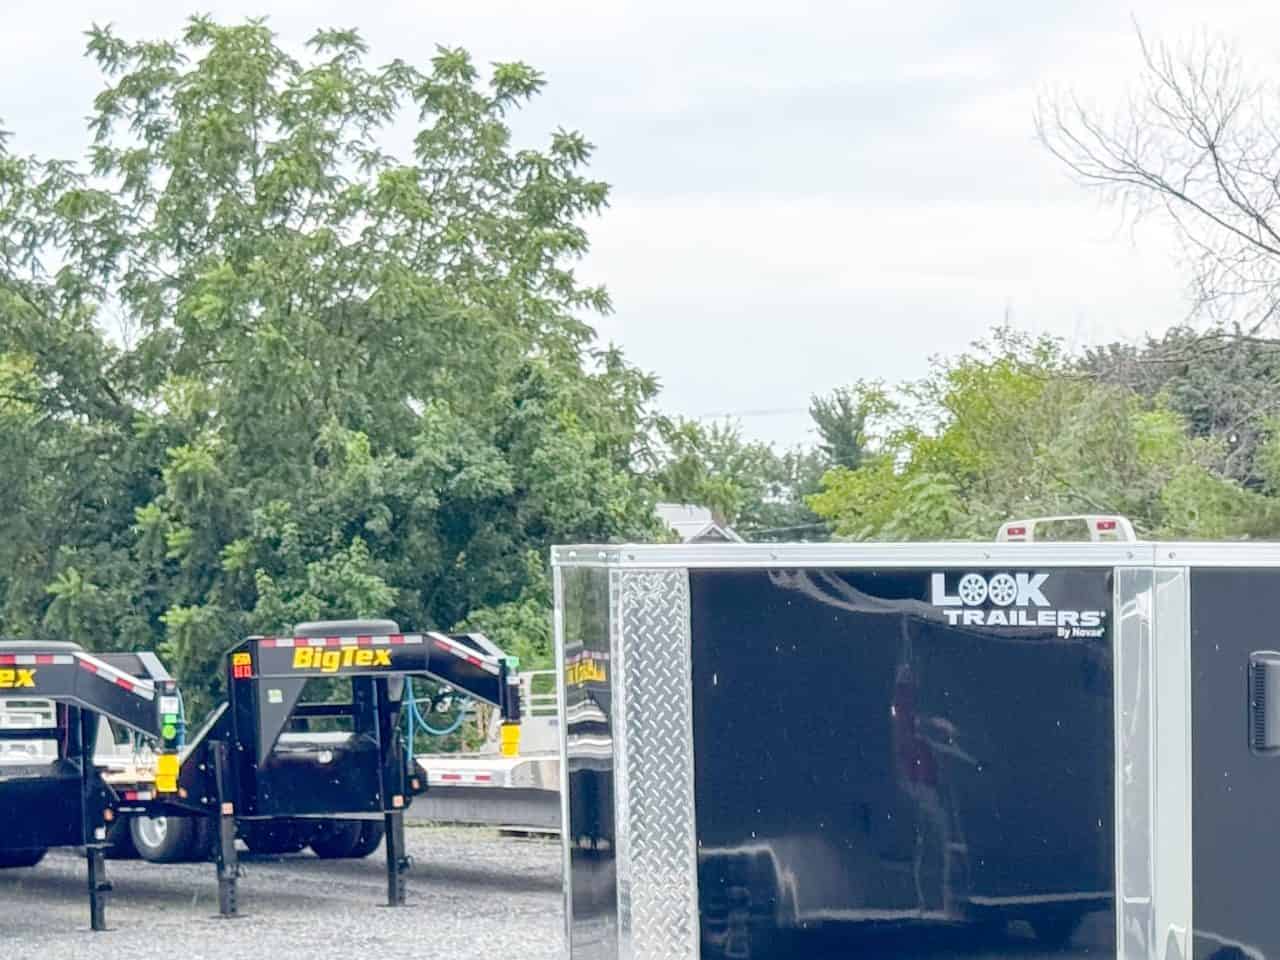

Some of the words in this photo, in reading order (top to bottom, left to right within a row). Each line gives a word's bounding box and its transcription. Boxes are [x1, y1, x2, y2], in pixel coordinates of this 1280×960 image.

[931, 572, 1051, 607] LOOK
[942, 609, 1103, 627] TRAILERS
[292, 645, 393, 673] BigTex
